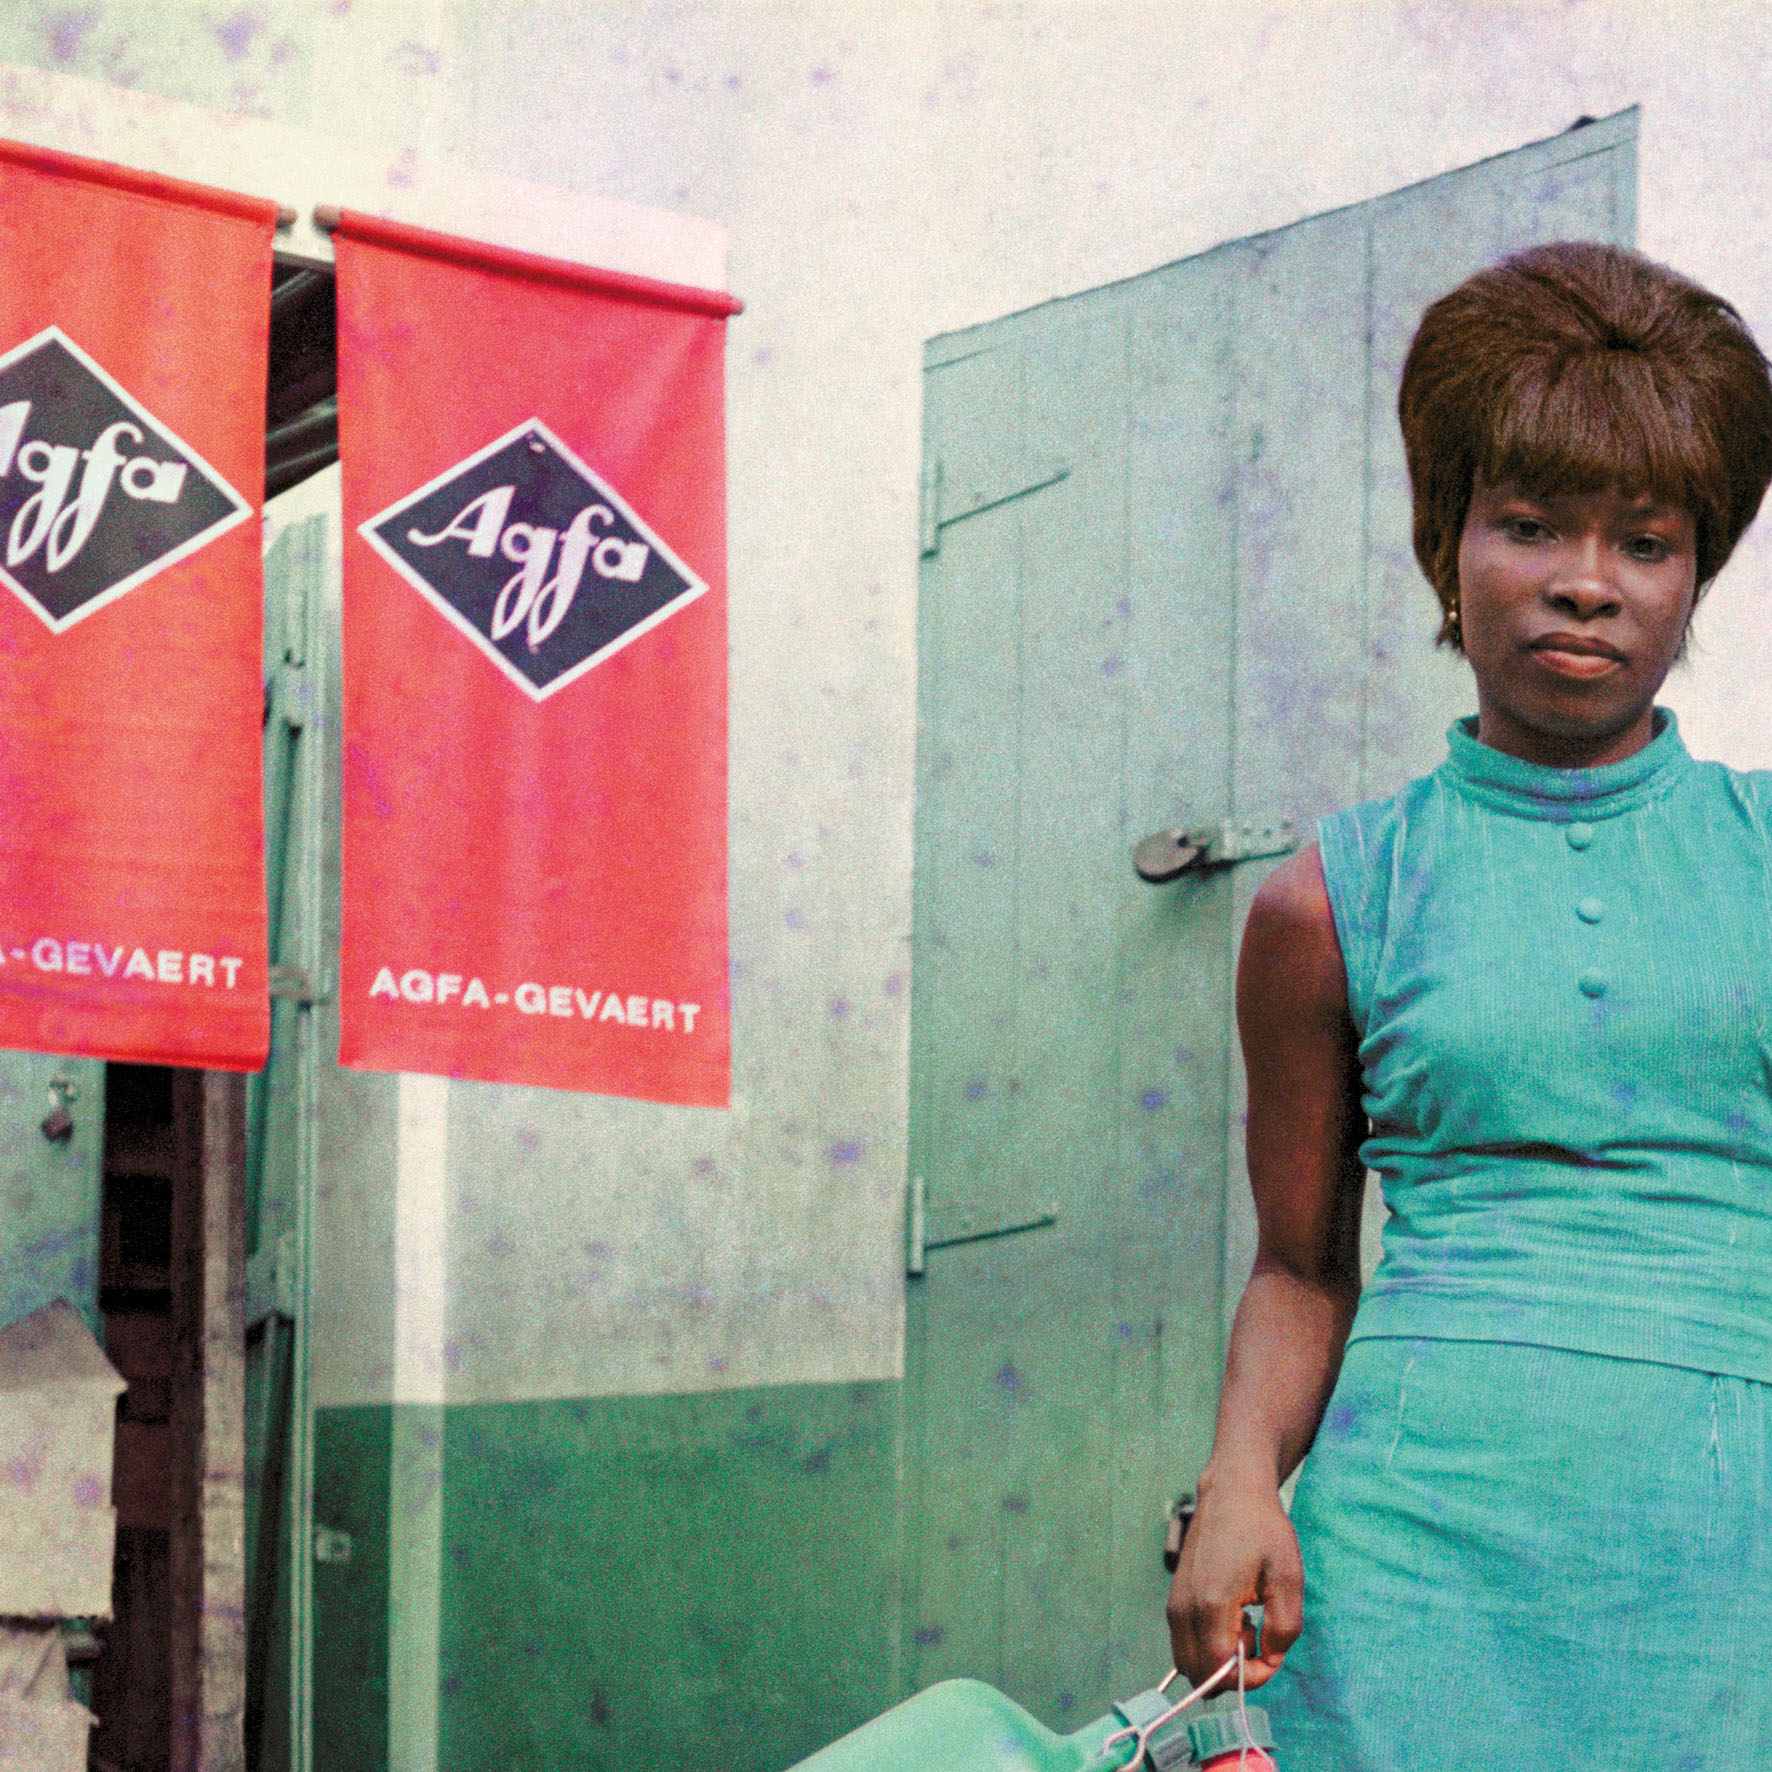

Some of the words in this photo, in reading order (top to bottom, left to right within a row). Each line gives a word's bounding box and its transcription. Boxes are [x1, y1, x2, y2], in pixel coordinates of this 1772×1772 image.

[408, 485, 649, 649] Agfa
[0, 936, 243, 989] -GEVAERT
[368, 966, 700, 1032] AGFA-GEVAERT
